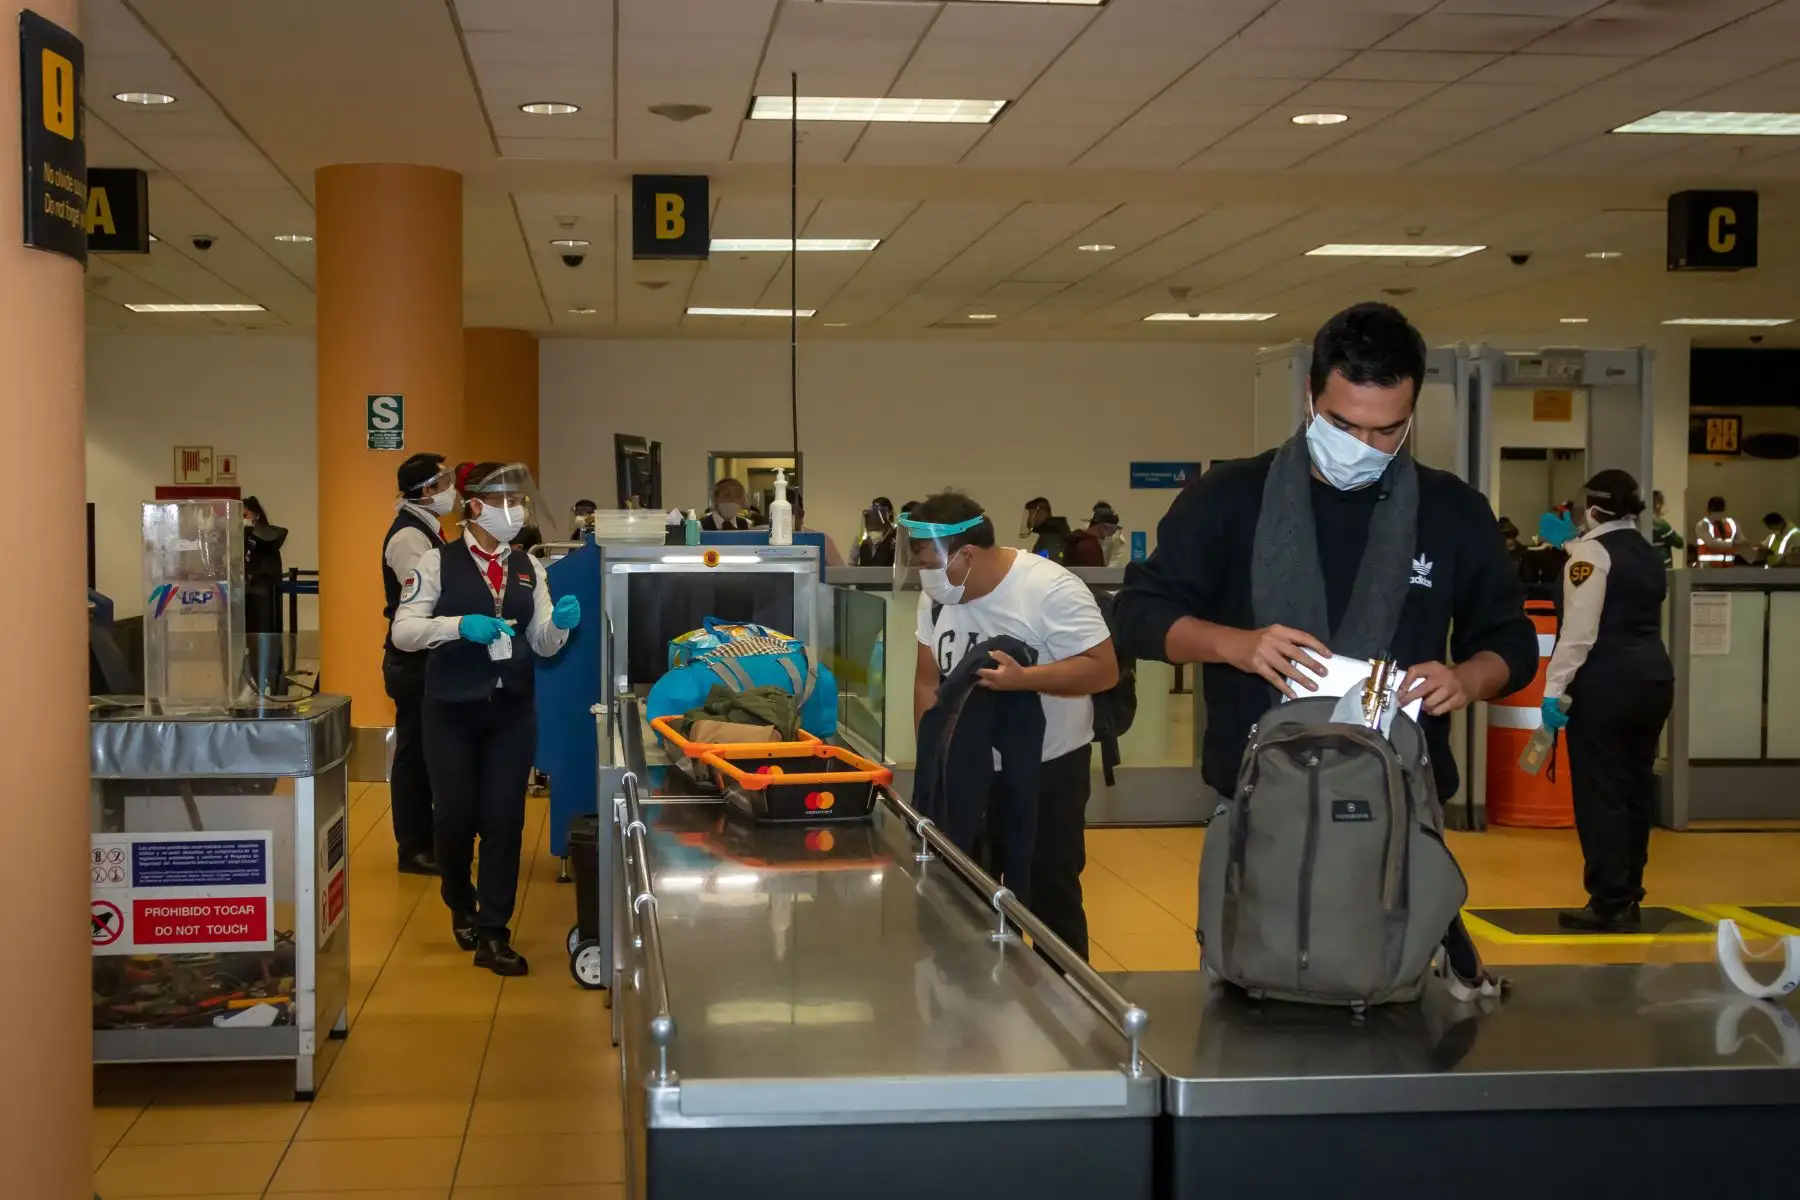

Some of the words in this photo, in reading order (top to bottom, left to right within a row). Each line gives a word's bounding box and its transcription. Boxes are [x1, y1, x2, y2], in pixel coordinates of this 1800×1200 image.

[44, 193, 55, 214] Do
[86, 187, 116, 234] A
[655, 193, 685, 240] B
[1708, 207, 1736, 253] C
[372, 396, 399, 429] S
[1571, 566, 1590, 581] SP
[144, 906, 211, 918] PROHIBIDO
[213, 905, 255, 916] TOCAR
[155, 926, 172, 936] DO
[175, 925, 200, 936] NOT
[206, 924, 248, 935] TOUCH
